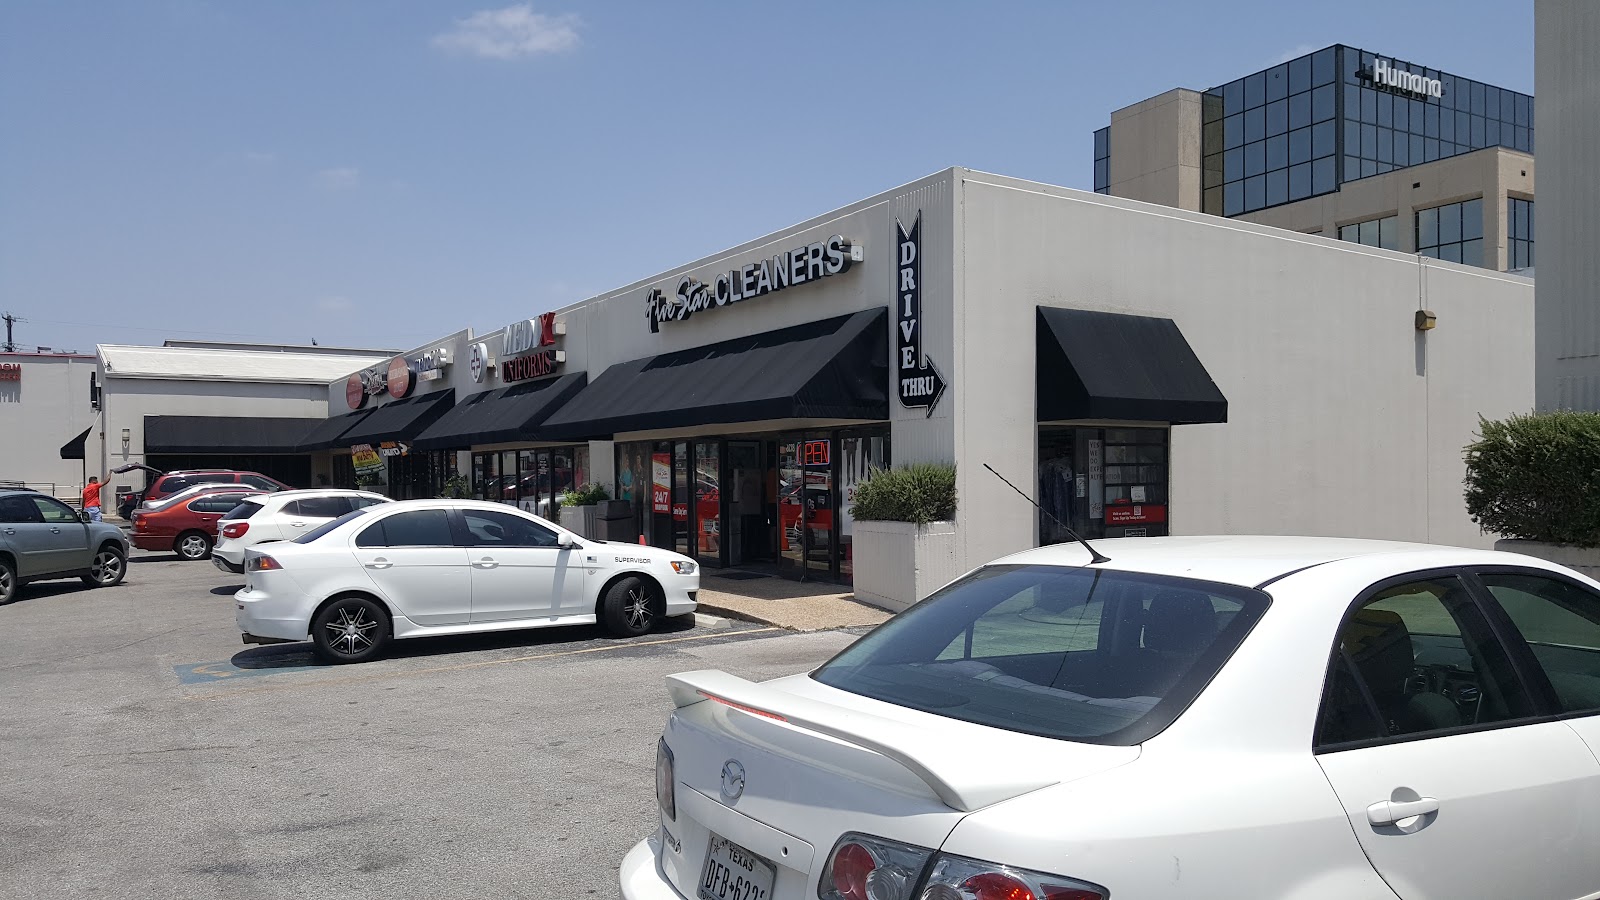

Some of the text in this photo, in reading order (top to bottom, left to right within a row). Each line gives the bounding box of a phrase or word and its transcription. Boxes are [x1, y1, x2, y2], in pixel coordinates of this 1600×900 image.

[1374, 58, 1441, 98] Humana
[645, 234, 848, 333] Five Star CLEANERS
[900, 241, 917, 370] DRIVE
[502, 350, 553, 383] UNIFORMS
[902, 376, 935, 397] THRU
[797, 441, 829, 465] OPEN
[654, 491, 669, 504] 24/7
[614, 556, 652, 564] SUPERVISOR
[728, 847, 755, 872] TEXAS
